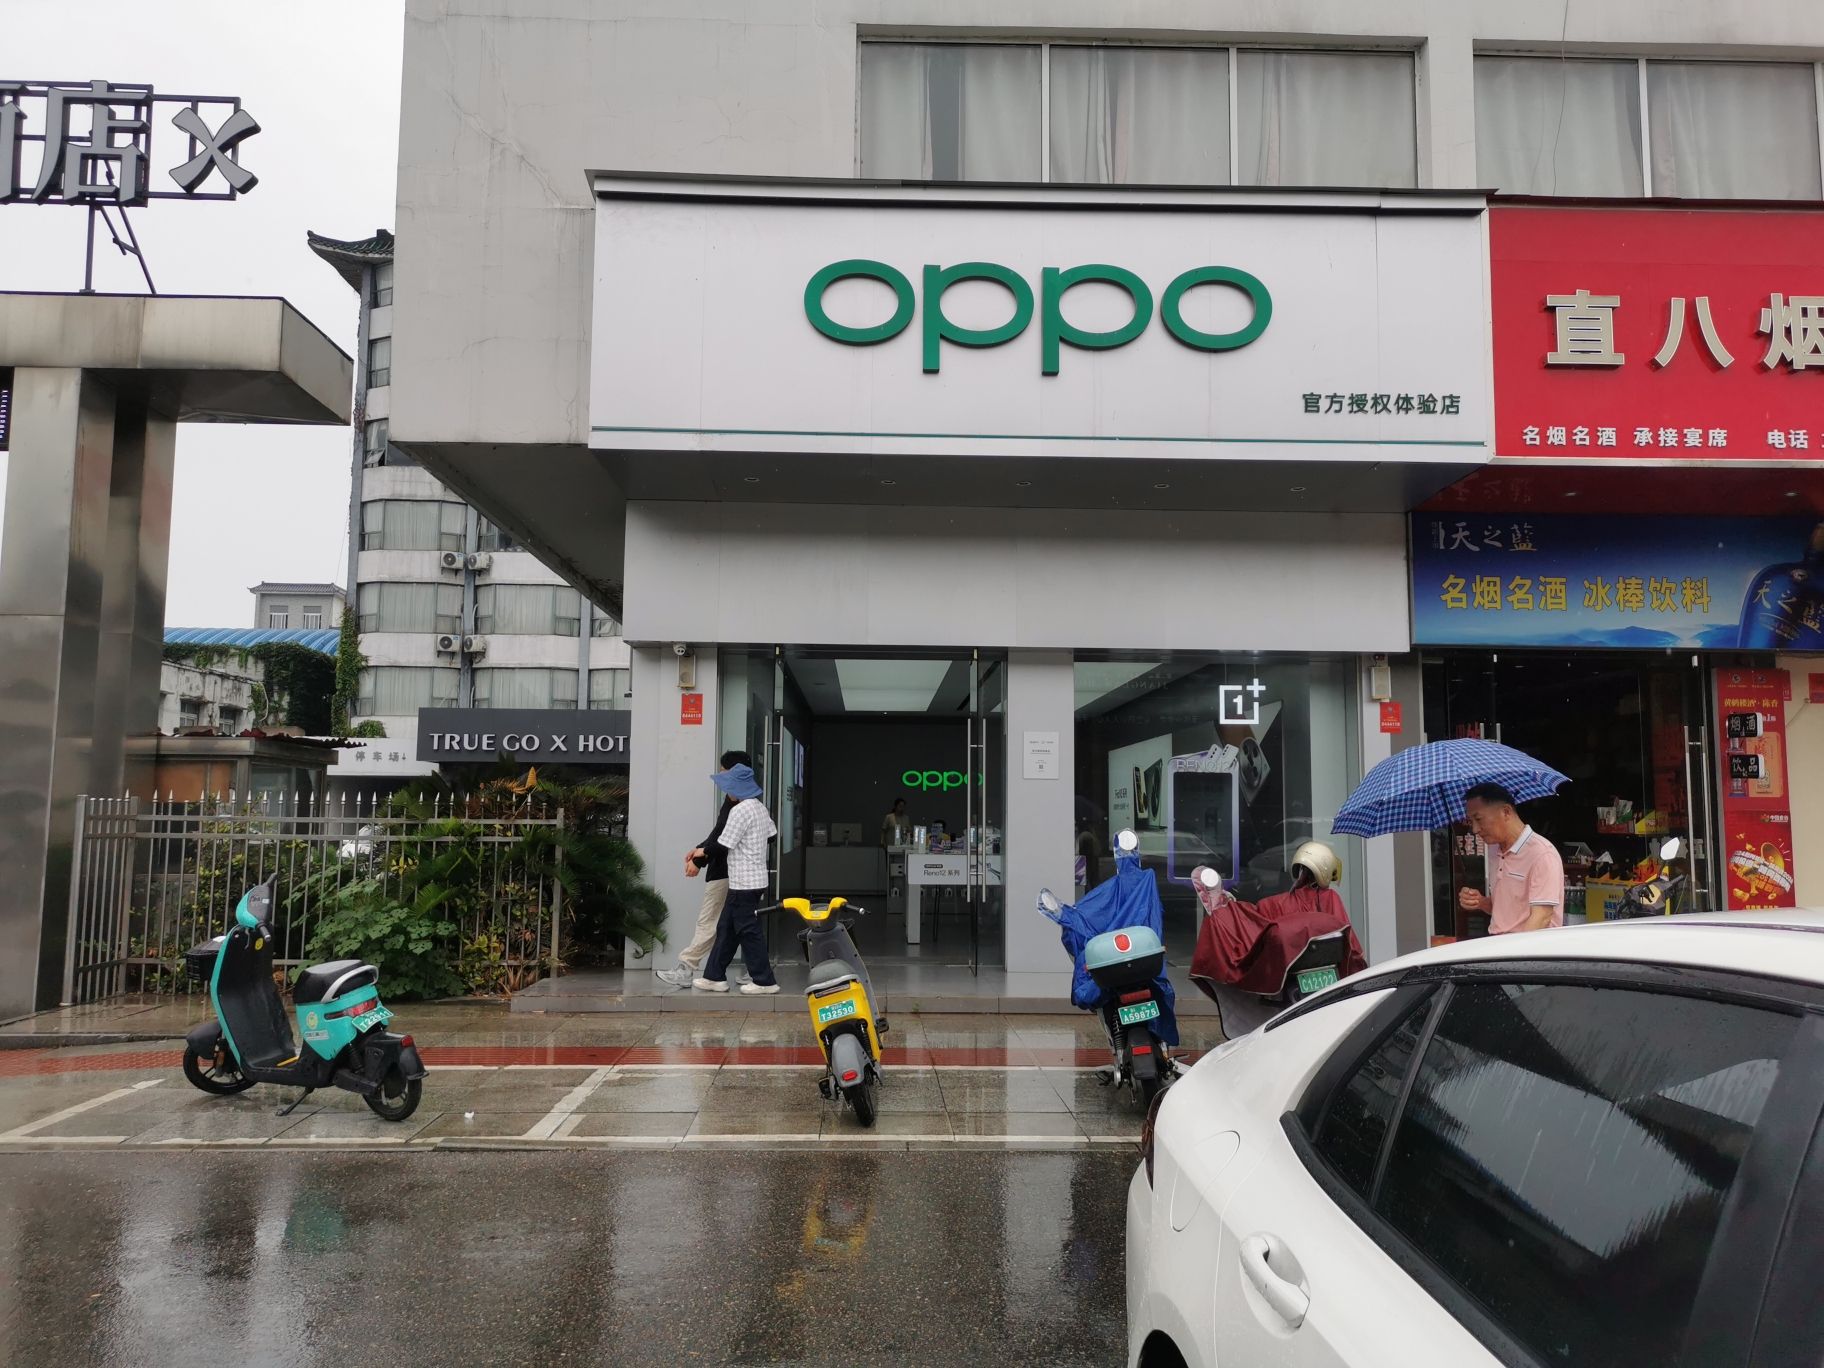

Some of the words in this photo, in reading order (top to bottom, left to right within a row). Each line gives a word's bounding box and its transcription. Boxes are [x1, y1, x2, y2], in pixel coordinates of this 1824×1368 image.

[0, 80, 152, 204] 店
[803, 259, 1273, 376] oppo
[1301, 392, 1462, 416] 官方授权体验店
[1522, 426, 1617, 448] 名烟名酒
[1633, 427, 1728, 448] 承接宴席
[1768, 429, 1809, 449] 电话
[1440, 574, 1568, 612] 名烟名酒
[1582, 576, 1711, 613] 冰棒饮料
[428, 733, 496, 751] TRUE
[502, 733, 540, 752] GO
[549, 734, 568, 752] X
[355, 751, 400, 762] 停车场
[821, 1005, 854, 1021] T32530
[1124, 1008, 1157, 1023] A59875
